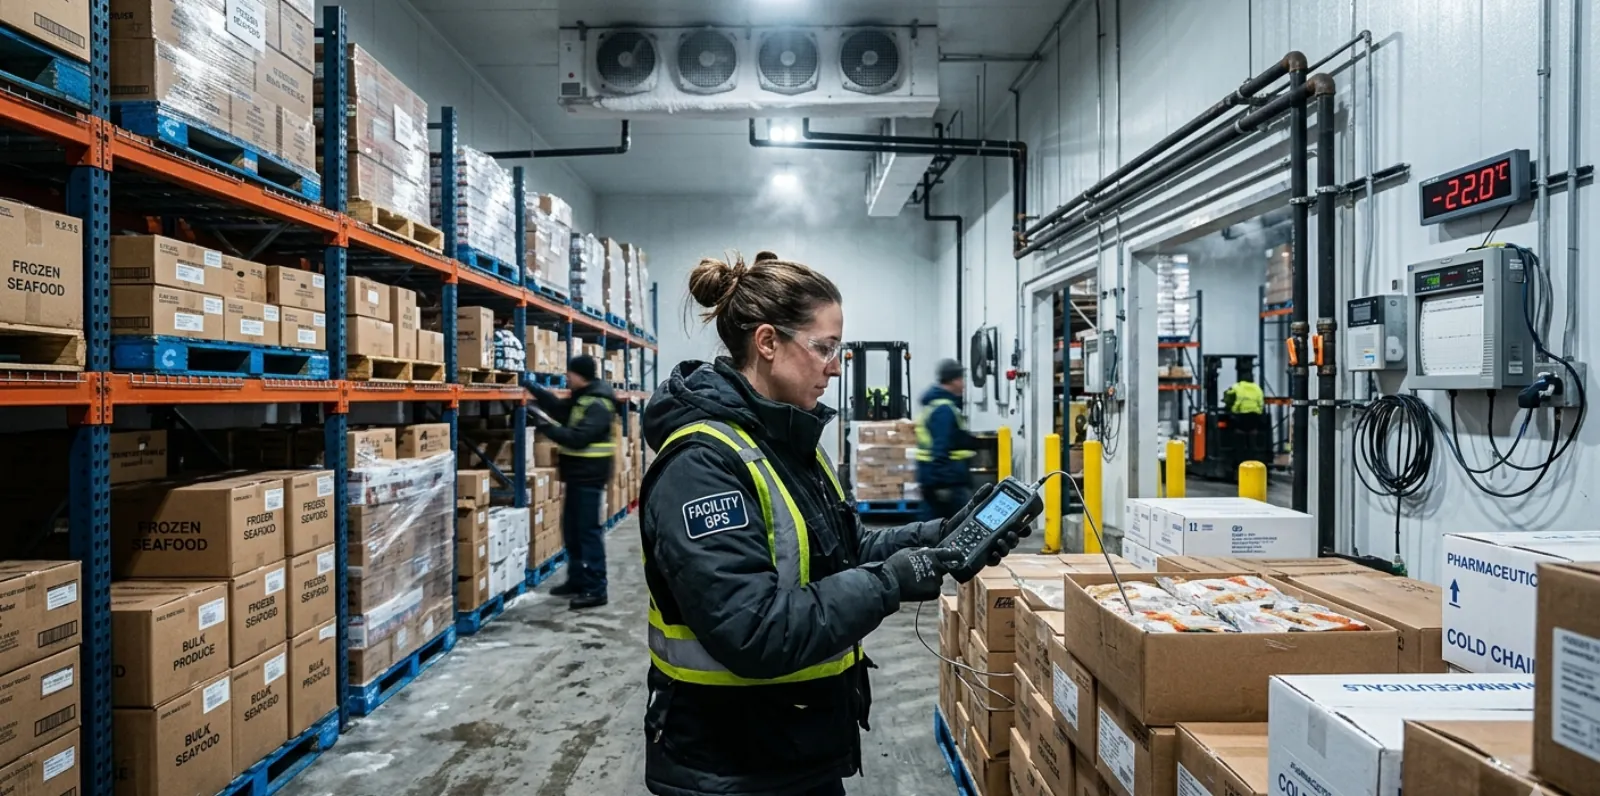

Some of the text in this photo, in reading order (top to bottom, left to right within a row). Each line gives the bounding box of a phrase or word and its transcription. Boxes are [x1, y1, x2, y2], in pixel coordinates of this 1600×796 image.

[7, 277, 65, 297] SEAFOOD
[688, 496, 739, 519] FACILITY
[138, 521, 201, 534] FROZEN
[131, 538, 208, 551] SEAFOOD
[182, 632, 206, 652] BULK
[1447, 628, 1536, 674] COLD CHAI
[173, 643, 215, 671] PRODUCE
[184, 722, 211, 748] BULK
